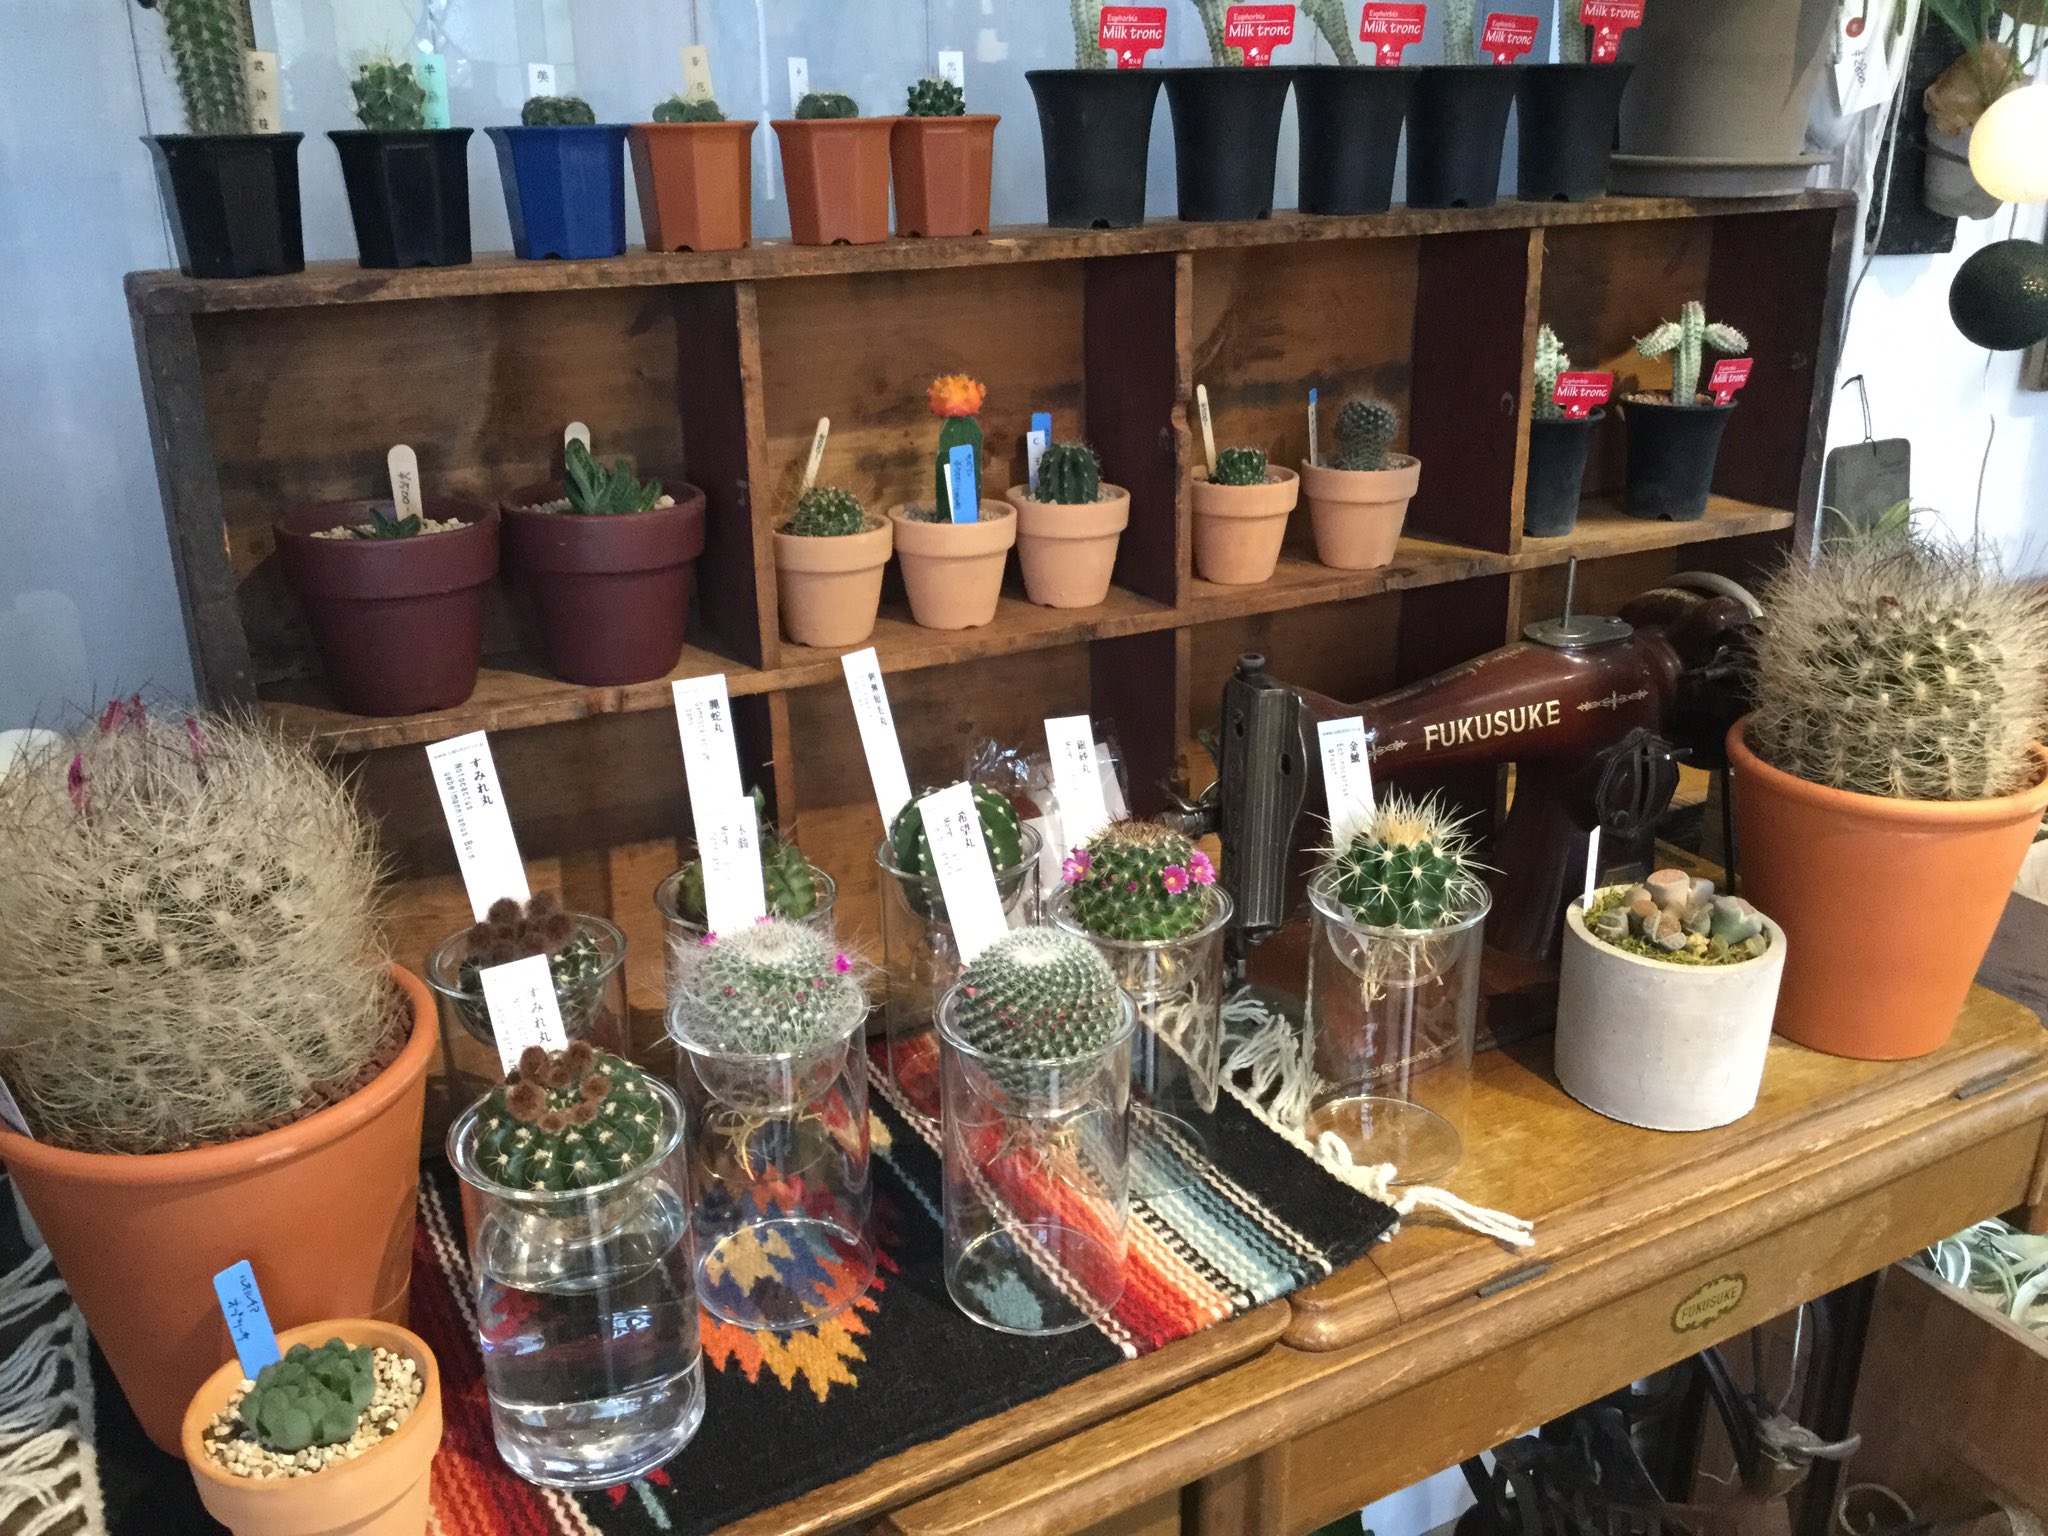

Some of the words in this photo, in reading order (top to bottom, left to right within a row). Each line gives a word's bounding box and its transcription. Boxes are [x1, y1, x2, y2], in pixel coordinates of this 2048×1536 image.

[1107, 14, 1138, 23] Euphorbia
[1234, 13, 1265, 21] Euphorbia
[1369, 9, 1398, 18] Euphorbia
[1585, 4, 1608, 17] Milk
[1610, 7, 1640, 19] tronc
[1103, 26, 1127, 39] Milk
[1130, 27, 1162, 39] tronc
[1229, 24, 1254, 37] Milk
[1257, 25, 1290, 37] tronc
[1364, 20, 1388, 33] Milk
[1390, 22, 1421, 34] tronc
[1485, 30, 1507, 43] Milk
[1507, 32, 1533, 45] tronc
[1713, 374, 1727, 383] Milk
[1728, 374, 1747, 383] tronc
[1557, 387, 1578, 397] Milk
[1580, 388, 1608, 398] tronc
[1423, 699, 1562, 751] FUKUSUKE
[454, 762, 474, 811] Notocactus
[470, 757, 494, 807] すみれ丸
[529, 987, 552, 1044] すみれ丸
[1681, 1286, 1738, 1321] FUKUSUKE
